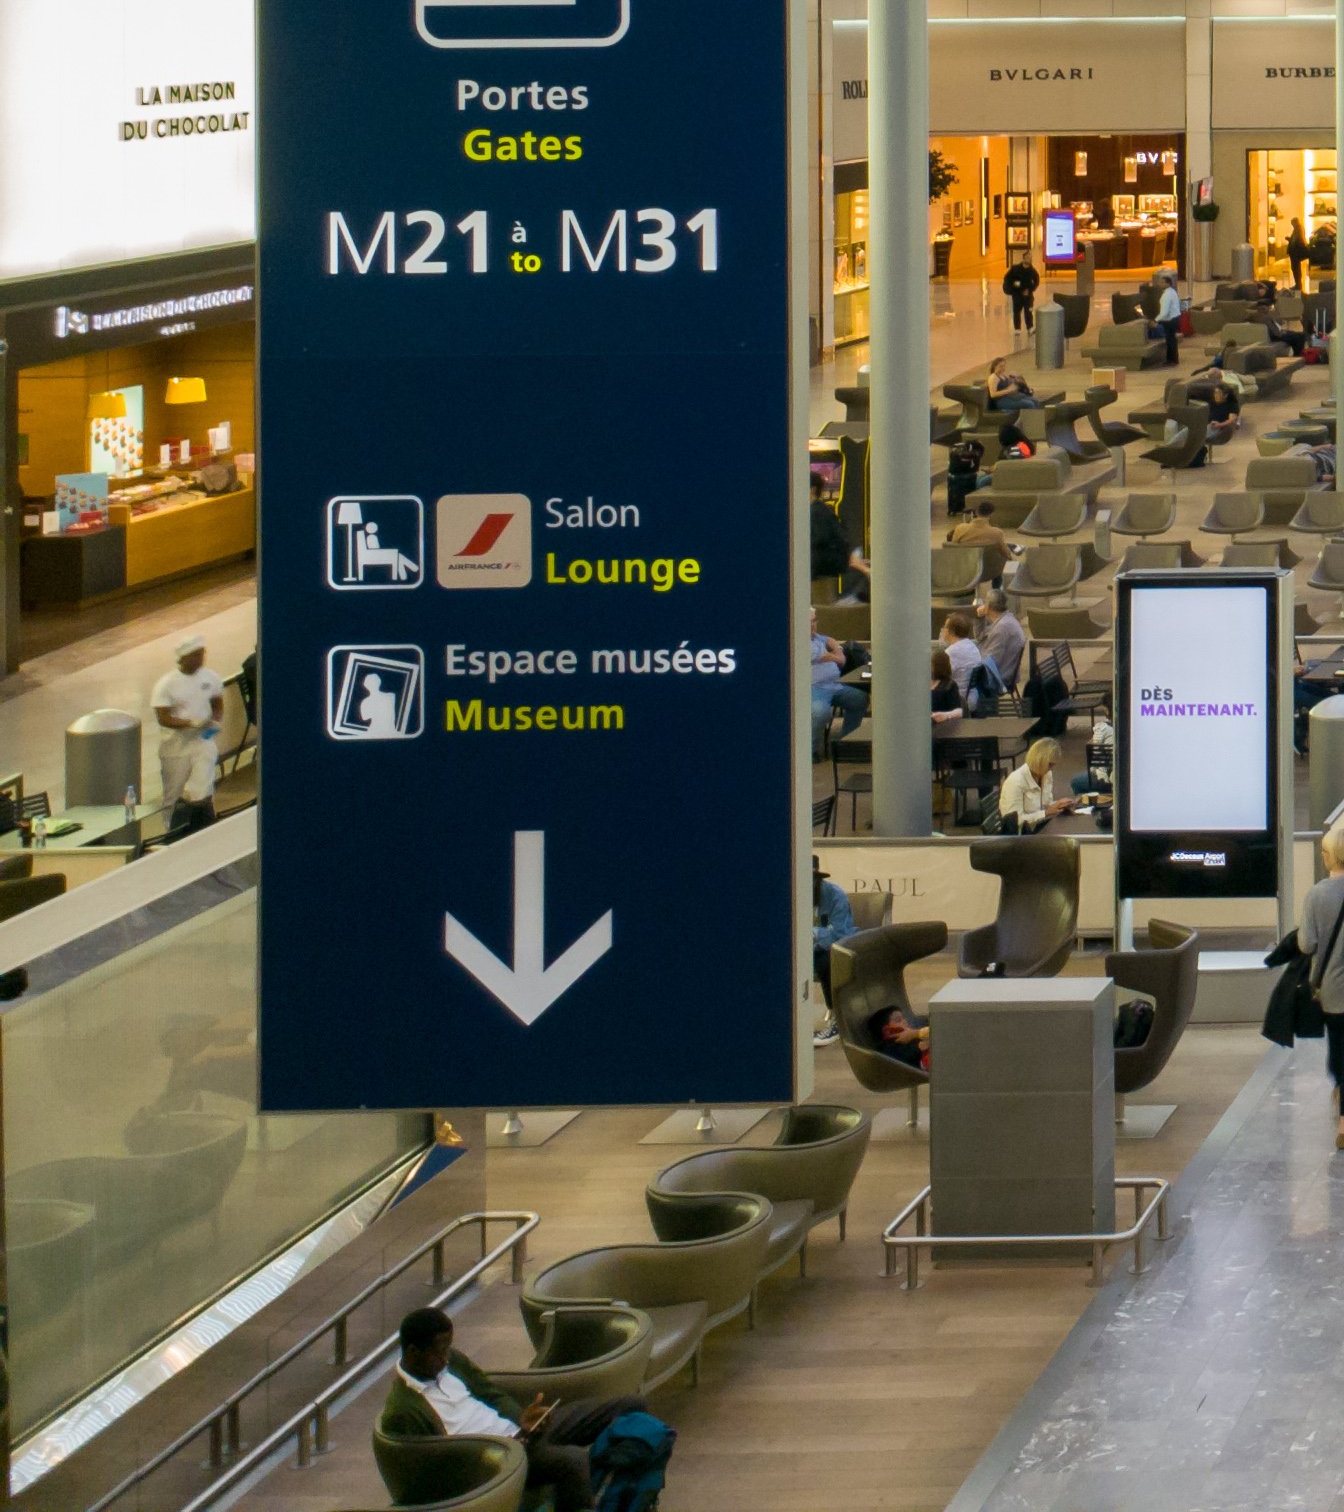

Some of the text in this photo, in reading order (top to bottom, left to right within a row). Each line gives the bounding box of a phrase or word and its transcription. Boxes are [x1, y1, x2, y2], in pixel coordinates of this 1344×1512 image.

[990, 68, 1093, 81] BVLGARI
[136, 81, 235, 106] LA MAISON
[458, 80, 589, 112] Portes
[119, 112, 250, 141] DU CHOCOLAT
[463, 129, 583, 162] Gates
[328, 208, 718, 275] M21 à M31
[512, 251, 541, 273] to
[545, 497, 640, 529] Salon
[547, 554, 700, 592] Lounge
[446, 641, 736, 684] Espace musées
[1140, 685, 1174, 701] DÈS
[445, 701, 624, 732] Museum
[1140, 704, 1258, 717] MAINTENANT.
[850, 878, 926, 897] PAUL
